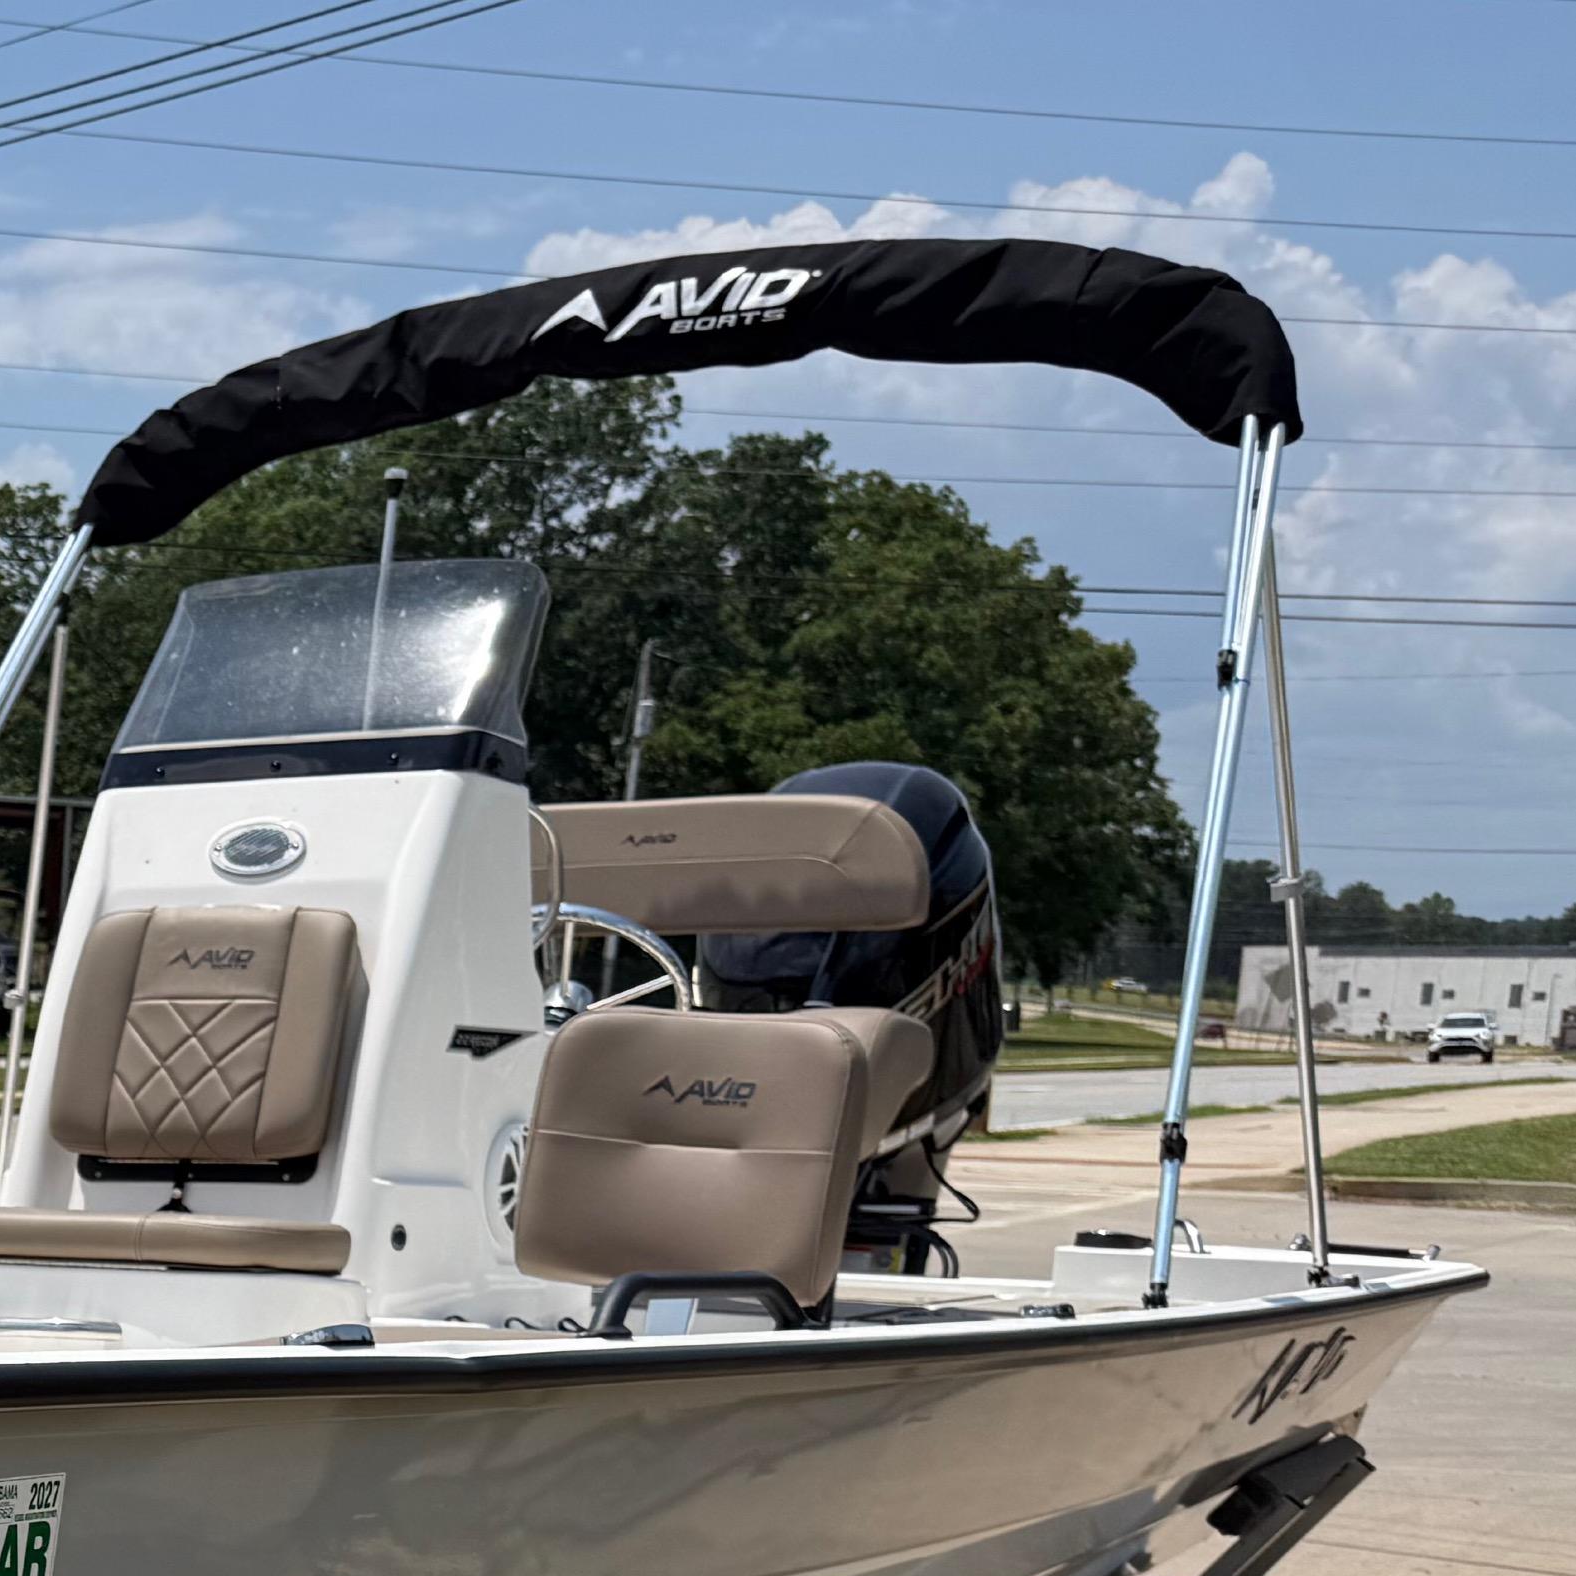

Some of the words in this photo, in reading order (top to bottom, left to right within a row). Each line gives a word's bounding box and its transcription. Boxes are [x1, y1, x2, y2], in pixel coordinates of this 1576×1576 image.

[603, 266, 812, 343] AVID
[669, 307, 787, 334] BOATS
[190, 946, 255, 970] AVID
[675, 1077, 758, 1103] AVID
[28, 1480, 61, 1510] 2027
